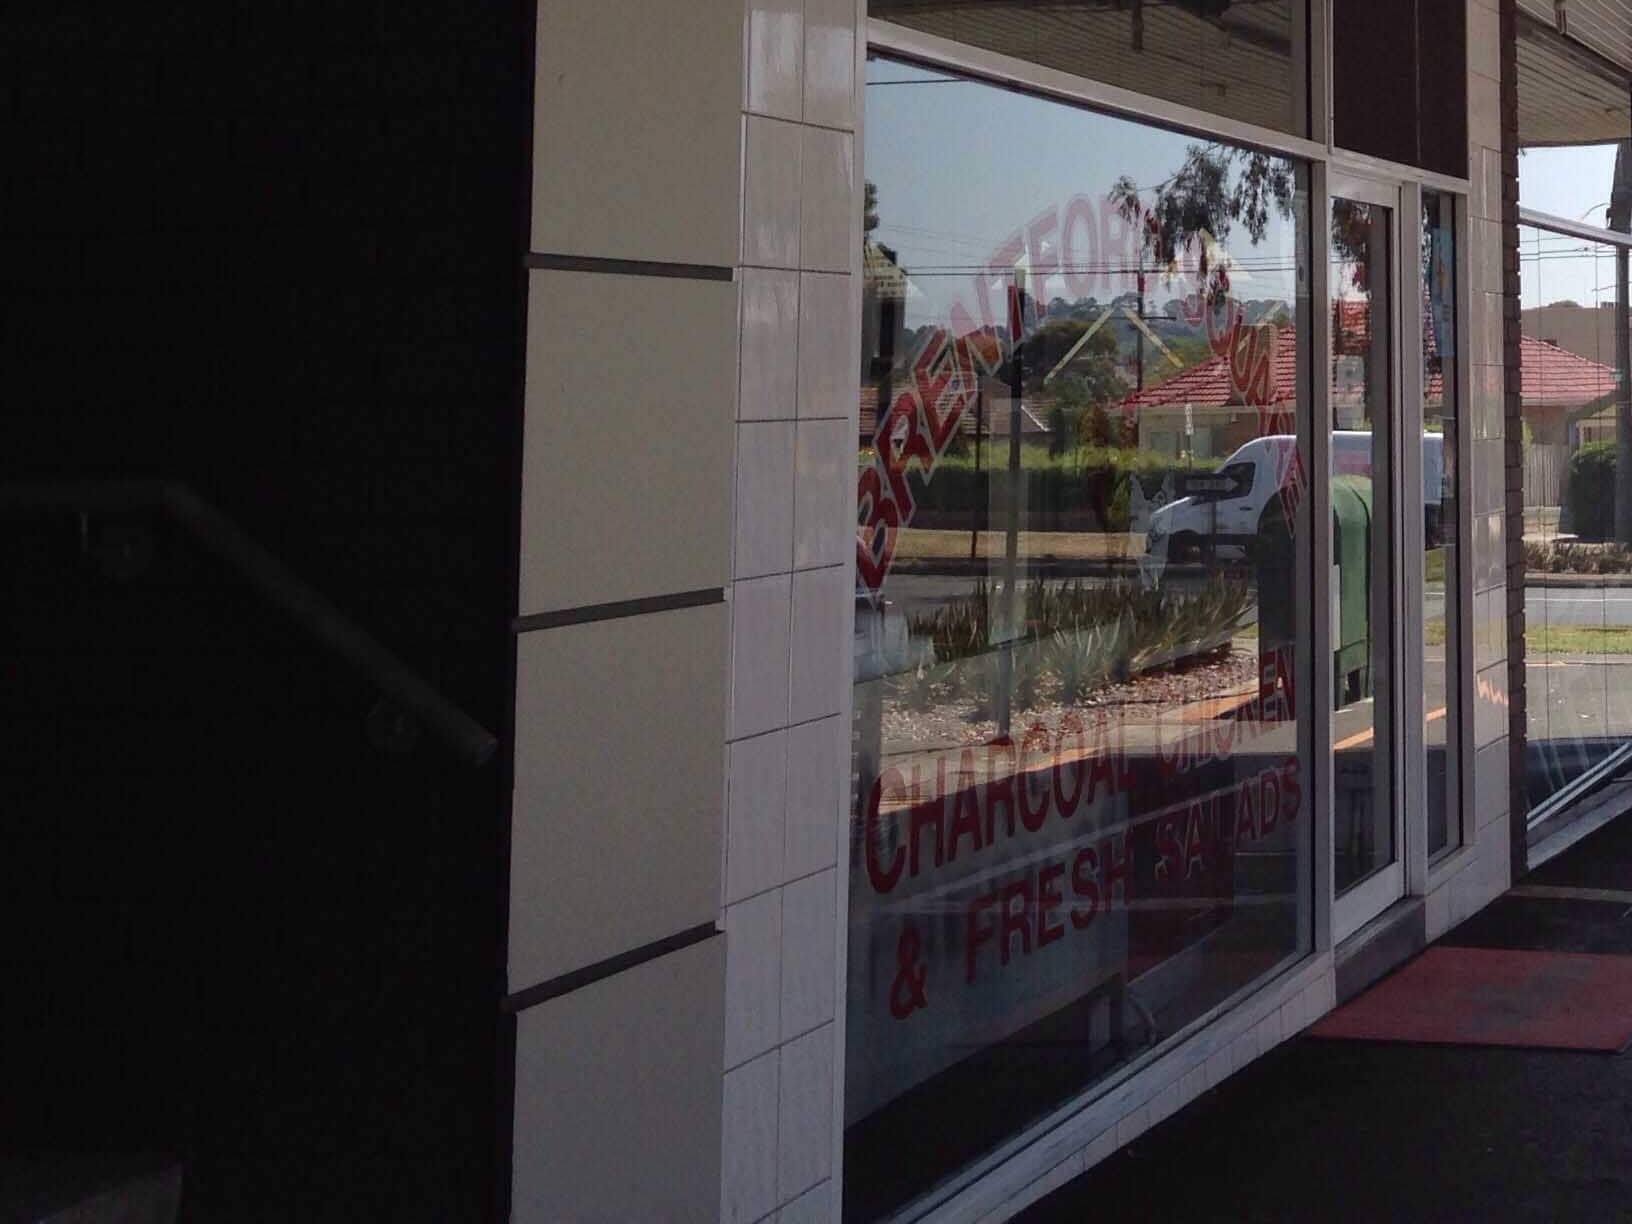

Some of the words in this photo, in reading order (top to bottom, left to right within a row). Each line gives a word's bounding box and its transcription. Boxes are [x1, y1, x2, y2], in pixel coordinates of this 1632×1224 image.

[865, 702, 1137, 894] CHARCOAL
[889, 919, 928, 1020] &
[964, 824, 1135, 984] FRESH
[1152, 755, 1302, 881] SALADS
